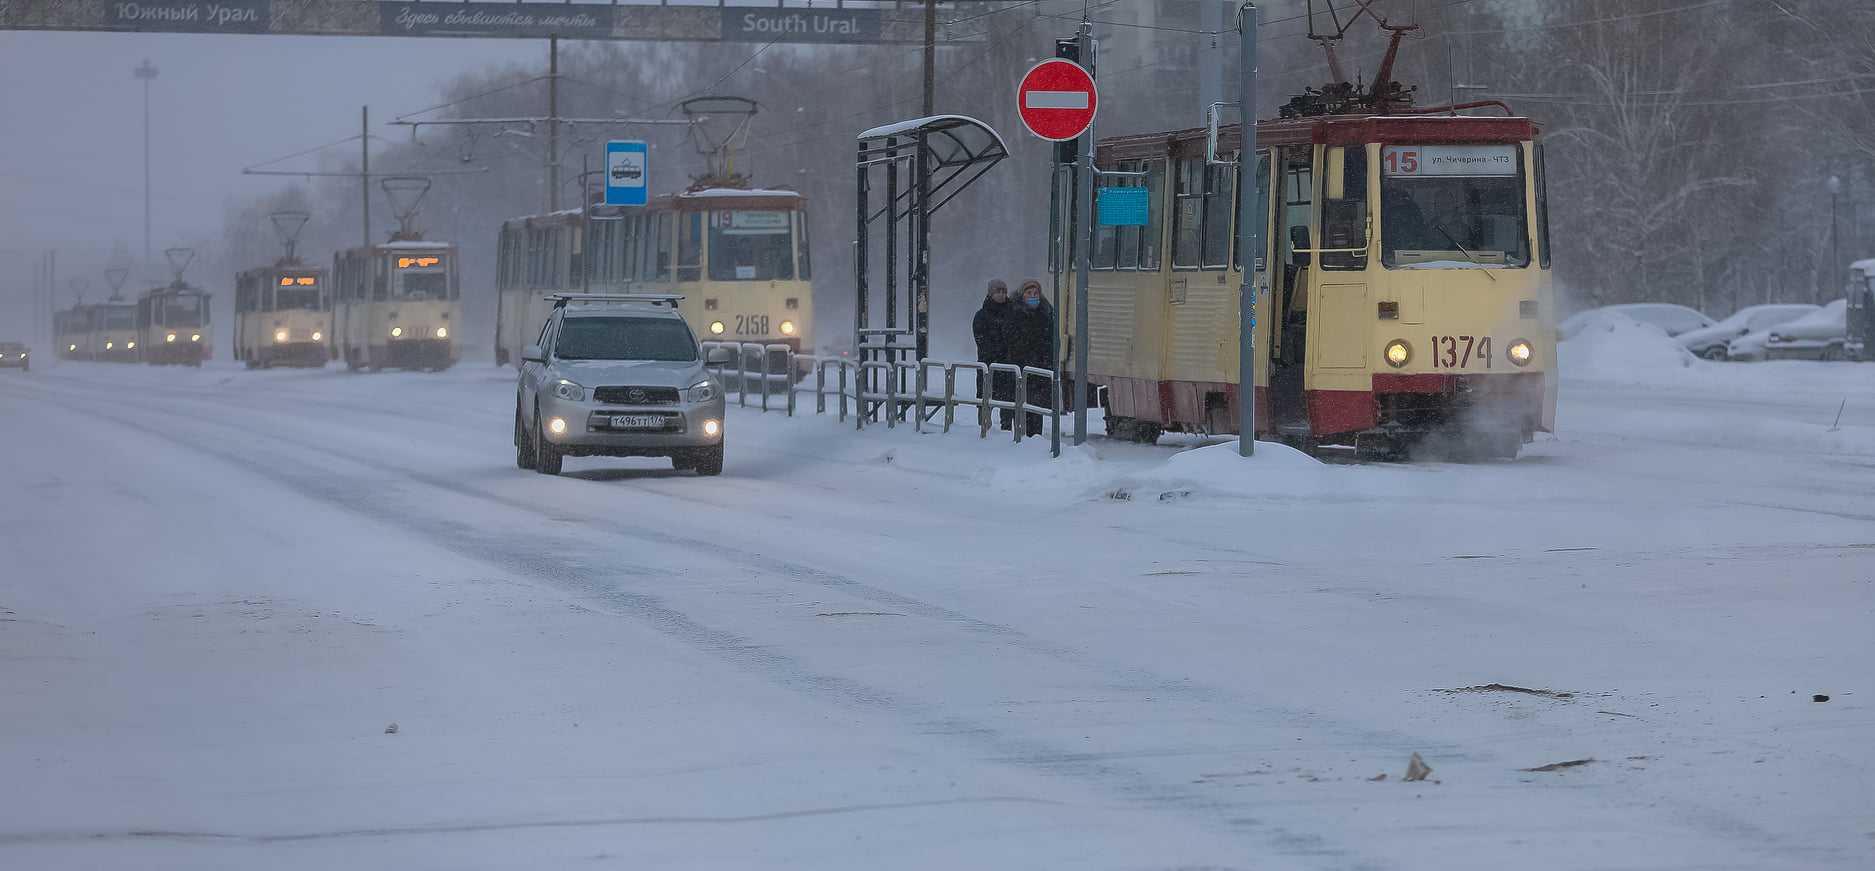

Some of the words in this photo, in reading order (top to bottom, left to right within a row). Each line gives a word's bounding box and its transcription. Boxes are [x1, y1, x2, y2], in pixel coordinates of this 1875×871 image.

[119, 2, 200, 21] Южный
[395, 7, 440, 31] Здесь
[444, 10, 533, 27] сбываются
[540, 12, 597, 28] мечты
[743, 13, 808, 33] South
[1384, 150, 1418, 173] 15
[735, 314, 769, 335] 2158
[1431, 335, 1493, 369] 1374
